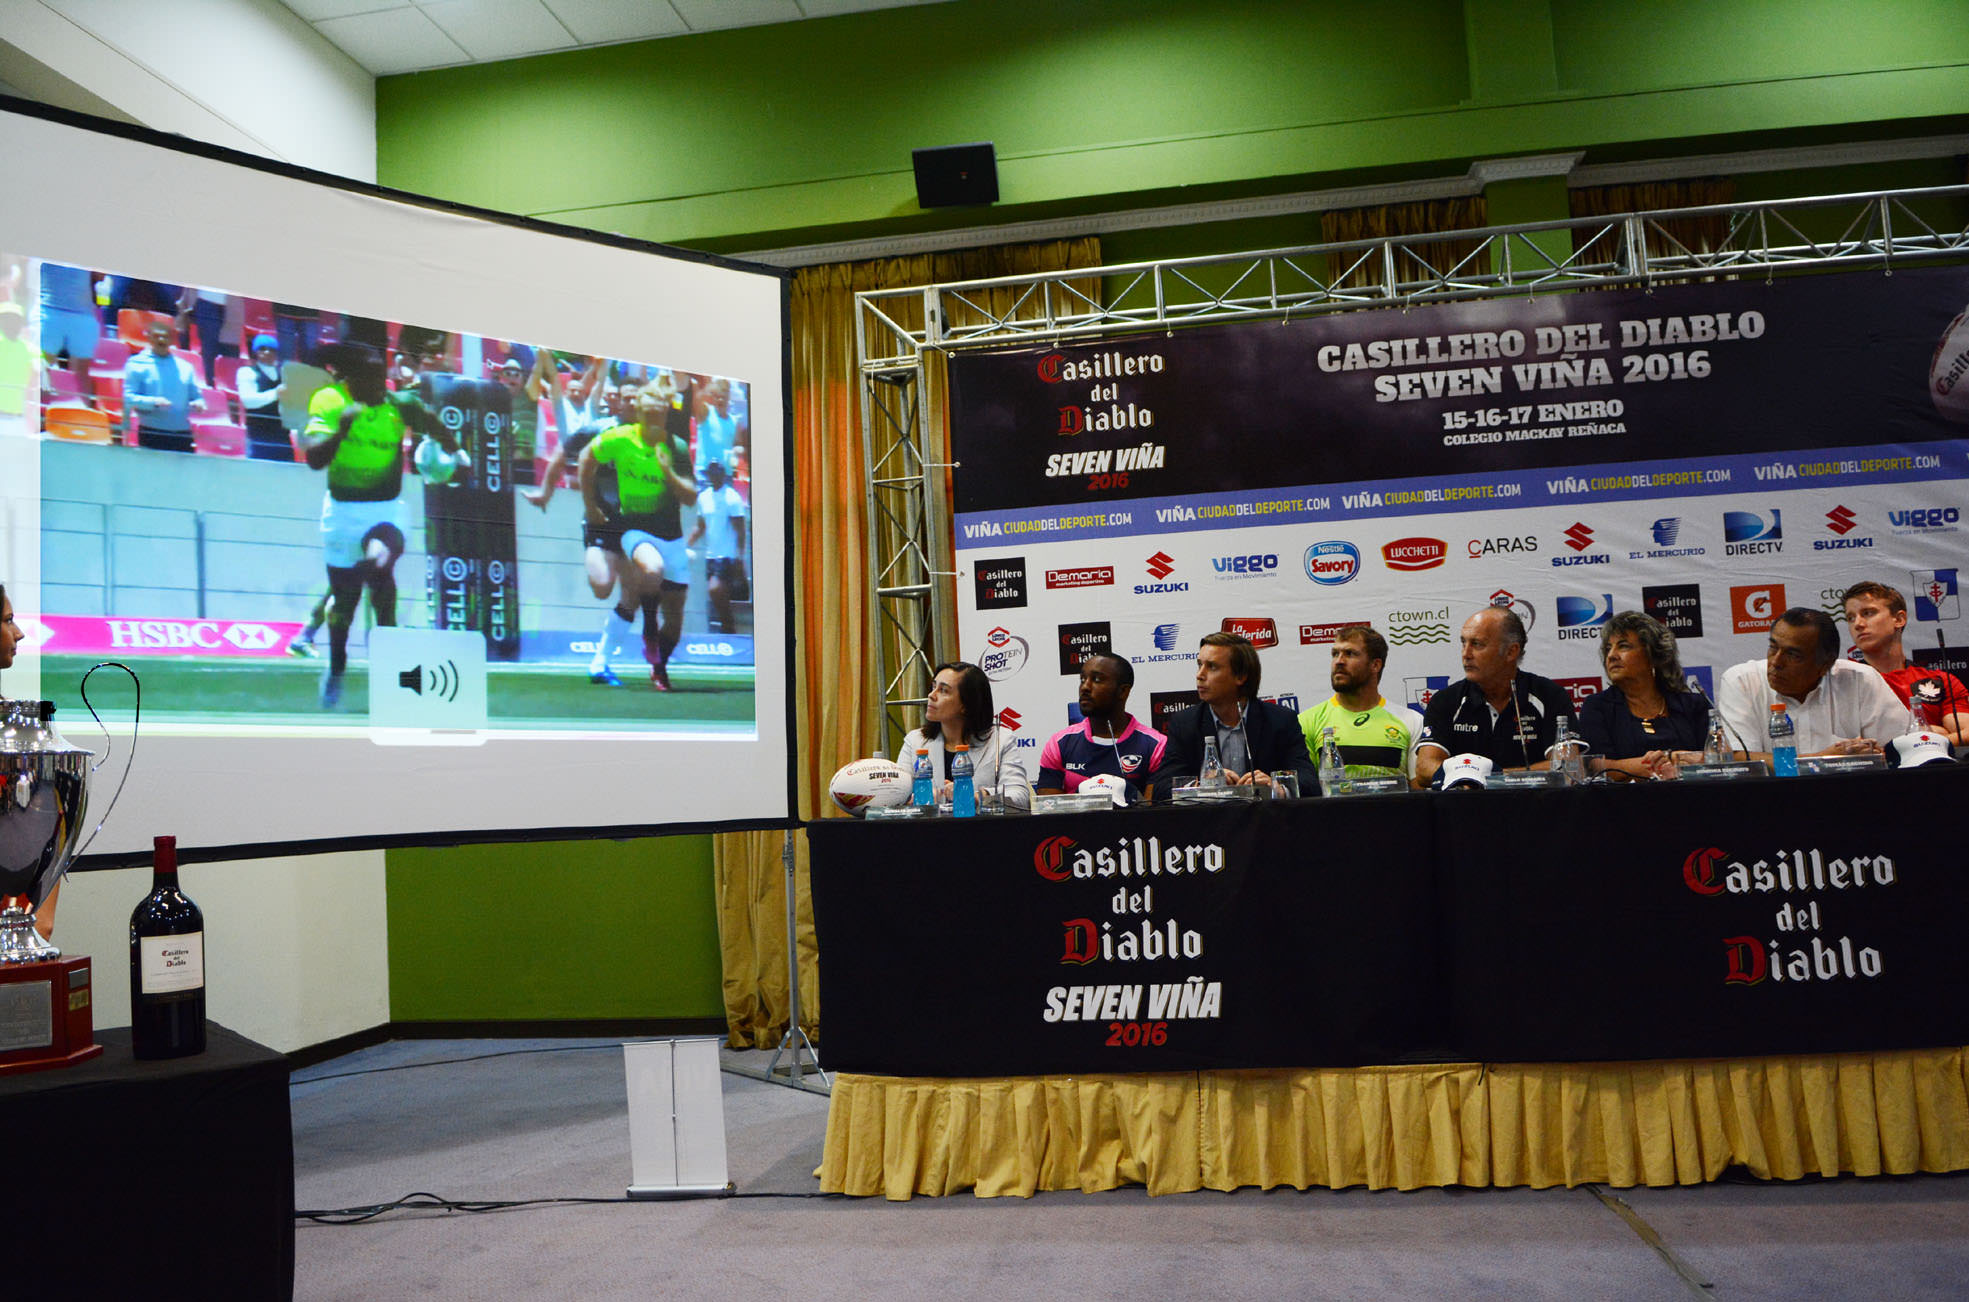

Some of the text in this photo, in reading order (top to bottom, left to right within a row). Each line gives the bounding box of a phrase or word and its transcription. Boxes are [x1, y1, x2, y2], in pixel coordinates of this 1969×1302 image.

[1317, 311, 1766, 373] CASILLERO DEL DIABLO
[1037, 352, 1165, 384] Casillero
[1375, 351, 1712, 403] SEVEN VIÑA 2016
[1091, 383, 1119, 402] del
[1057, 403, 1154, 436] Diablo
[1443, 399, 1624, 430] 15-16-17 ENERO
[1443, 422, 1626, 447] COLEGIO MACKAY REÑACA
[1045, 442, 1165, 477] SEVEN VIÑA
[1753, 462, 1797, 481] VIÑA
[1087, 473, 1129, 490] 2016
[1547, 476, 1590, 495] VIÑA
[1341, 491, 1383, 510] VIÑA
[1155, 505, 1196, 523] VIÑA
[964, 520, 1002, 539] VIÑA
[1390, 545, 1439, 558] LUCCHETTI
[1468, 536, 1538, 557] CARAS
[1629, 547, 1705, 559] EL MERCURIO
[1726, 541, 1782, 556] DIRECTV
[1813, 537, 1873, 550] SUZUKI
[1311, 558, 1354, 574] Savory
[1552, 554, 1610, 567] SUZUKI
[977, 570, 1022, 581] Casillero
[996, 580, 1006, 588] del
[1048, 570, 1111, 582] Demaria
[985, 588, 1018, 599] Diablo
[1133, 582, 1189, 595] SUZUKI
[1388, 606, 1450, 623] ctown.cl
[1738, 620, 1775, 628] GATORA
[105, 620, 221, 648] HSBC
[1232, 623, 1243, 633] La
[1062, 634, 1107, 645] Casillero
[984, 659, 1008, 671] SHOT
[1131, 656, 1145, 664] EL
[1454, 723, 1478, 732] mitre
[1034, 835, 1225, 882] Casillero
[1683, 847, 1897, 896] Casillero
[1112, 885, 1153, 914] del
[1776, 901, 1823, 932] del
[1060, 917, 1204, 966] Diablo
[1722, 936, 1884, 986] Diablo
[1043, 976, 1222, 1023] SEVEN VIÑA
[1105, 1022, 1168, 1047] 2016
